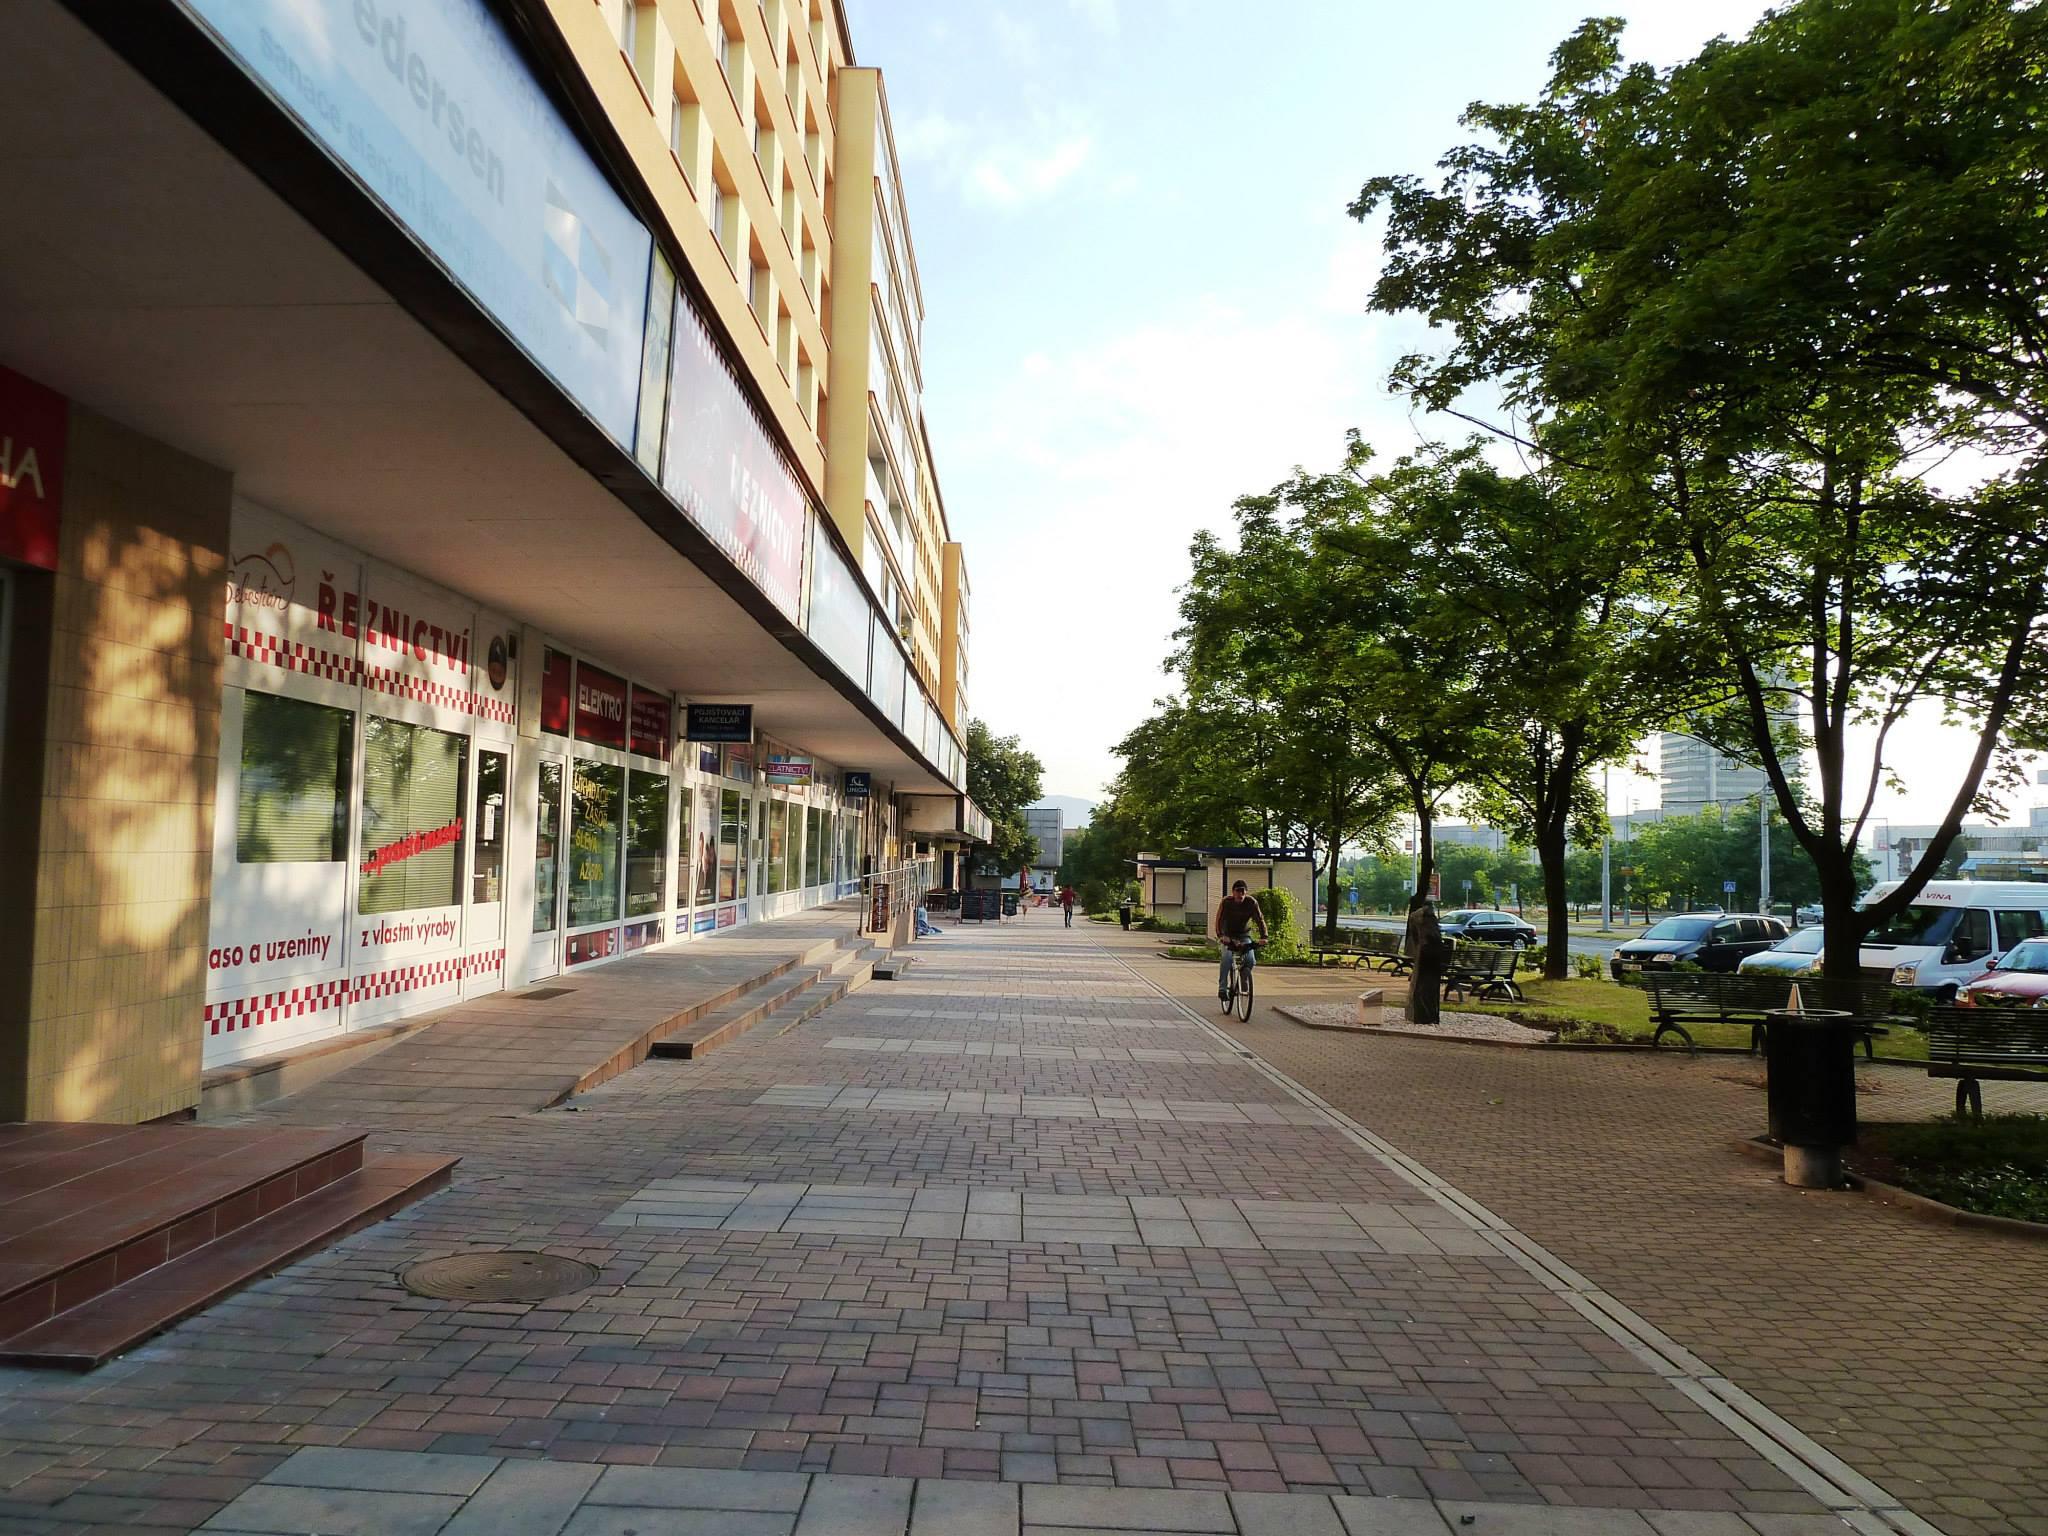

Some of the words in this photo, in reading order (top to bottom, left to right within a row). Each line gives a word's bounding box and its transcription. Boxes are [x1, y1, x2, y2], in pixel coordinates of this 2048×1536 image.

[317, 569, 470, 675] ŘEZNICTVÍ
[578, 684, 622, 722] ELEKTRO
[249, 943, 261, 963] a
[266, 928, 331, 961] uzeniny
[361, 930, 369, 947] z
[373, 919, 414, 946] vlastní
[416, 914, 456, 945] výroby
